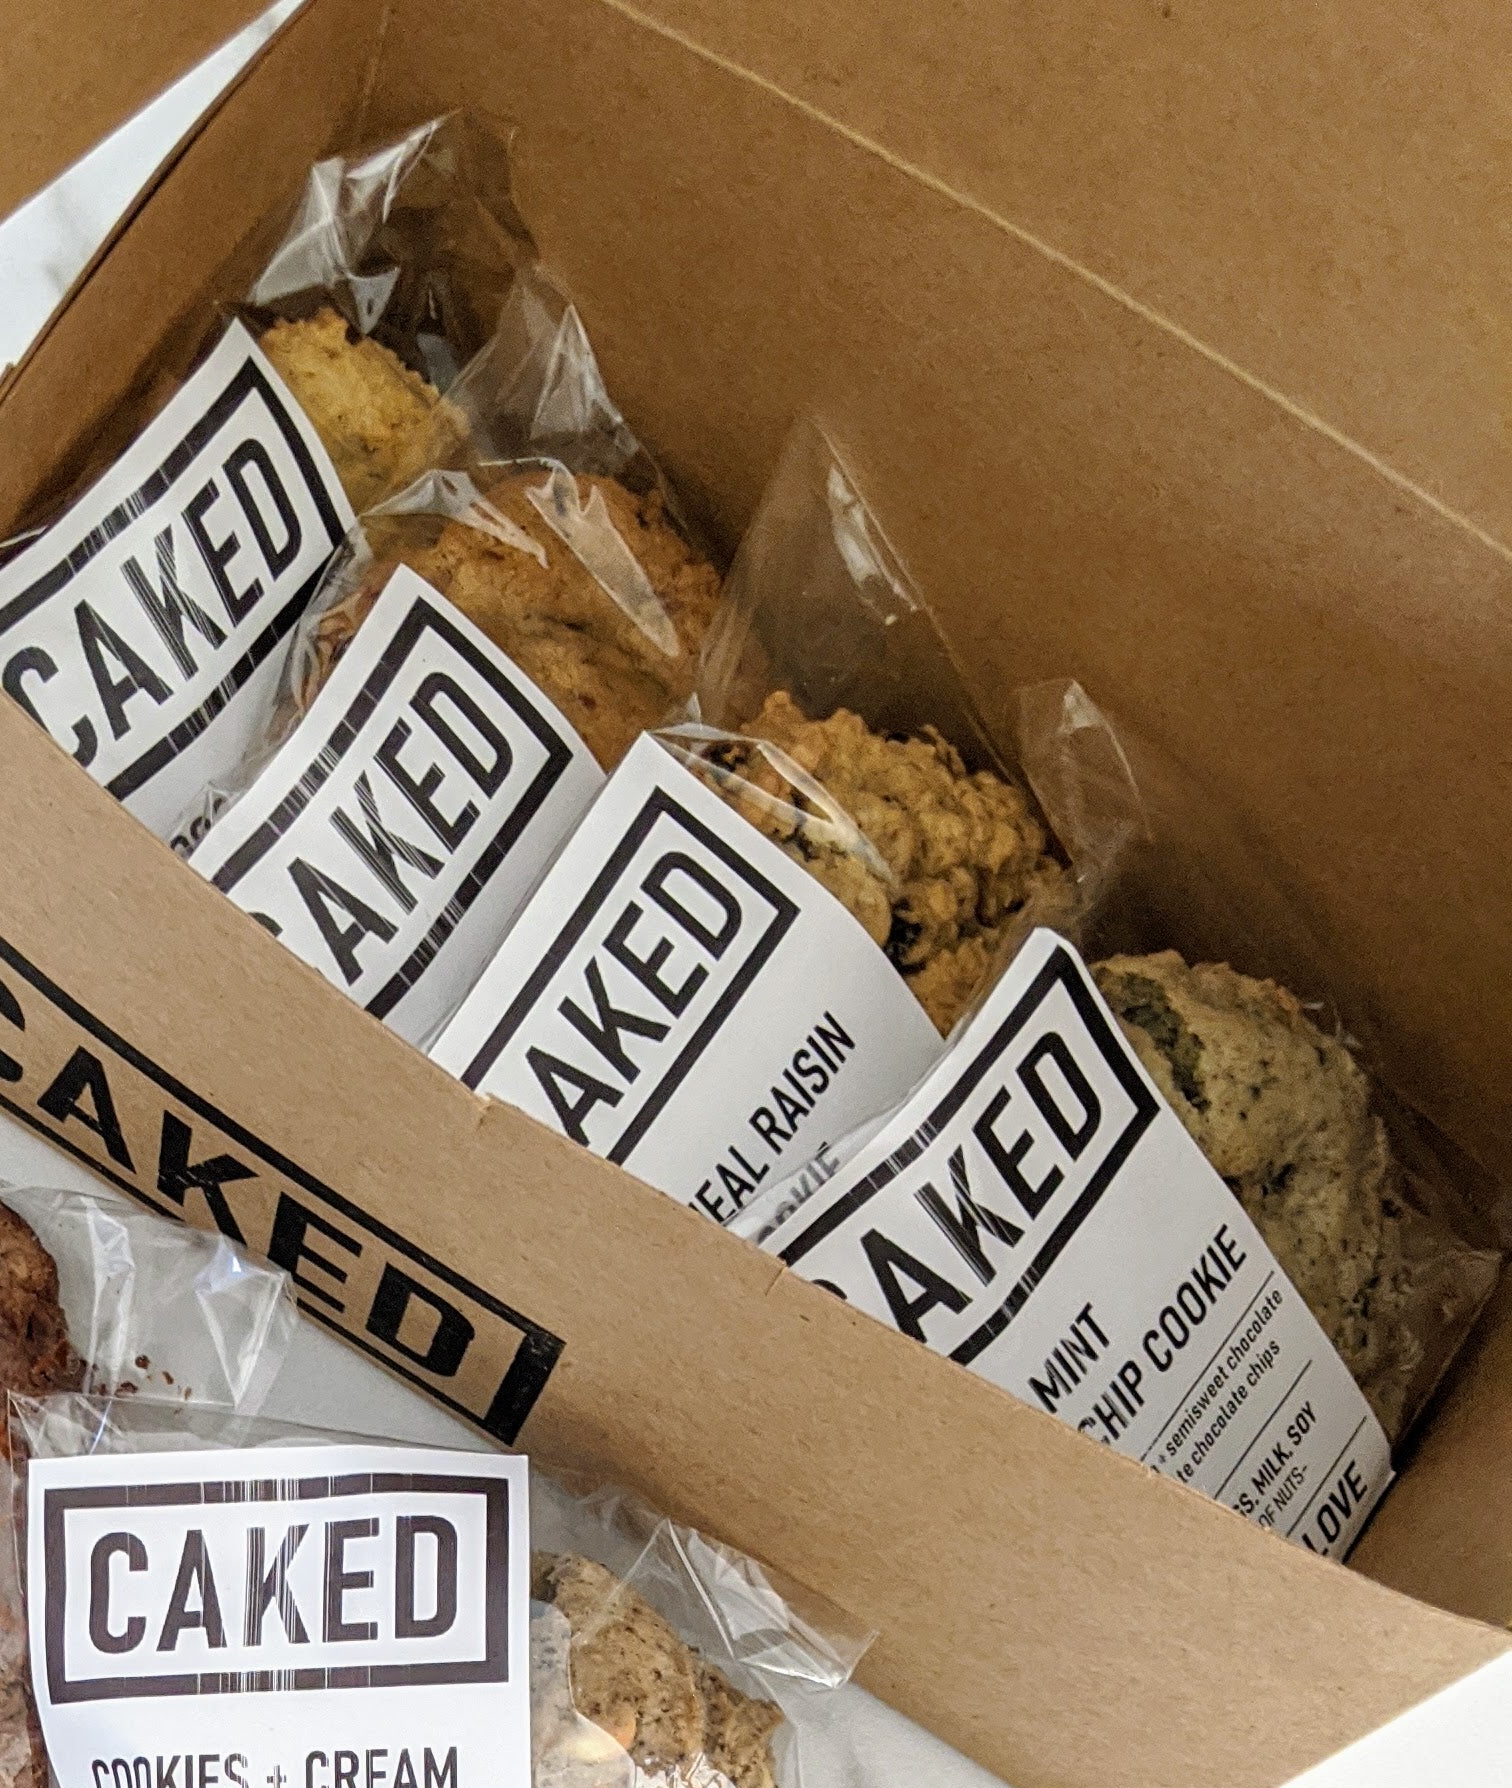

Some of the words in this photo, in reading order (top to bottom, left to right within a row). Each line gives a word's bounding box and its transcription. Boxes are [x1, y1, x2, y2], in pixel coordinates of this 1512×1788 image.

[3, 438, 302, 766] CAKED
[248, 670, 513, 986] AKED
[748, 1010, 855, 1156] RAISIN
[811, 1031, 1105, 1342] AKED
[1027, 1301, 1109, 1413] MINT
[1142, 1223, 1247, 1372] COOKIE
[1166, 1365, 1229, 1456] semisweet
[1226, 1290, 1282, 1371] chocolate
[1191, 1391, 1243, 1465] chocolate
[1237, 1340, 1280, 1399] chips
[1251, 1445, 1291, 1496] MILK,
[1286, 1400, 1316, 1446] SOY
[88, 1515, 458, 1654] CAKED
